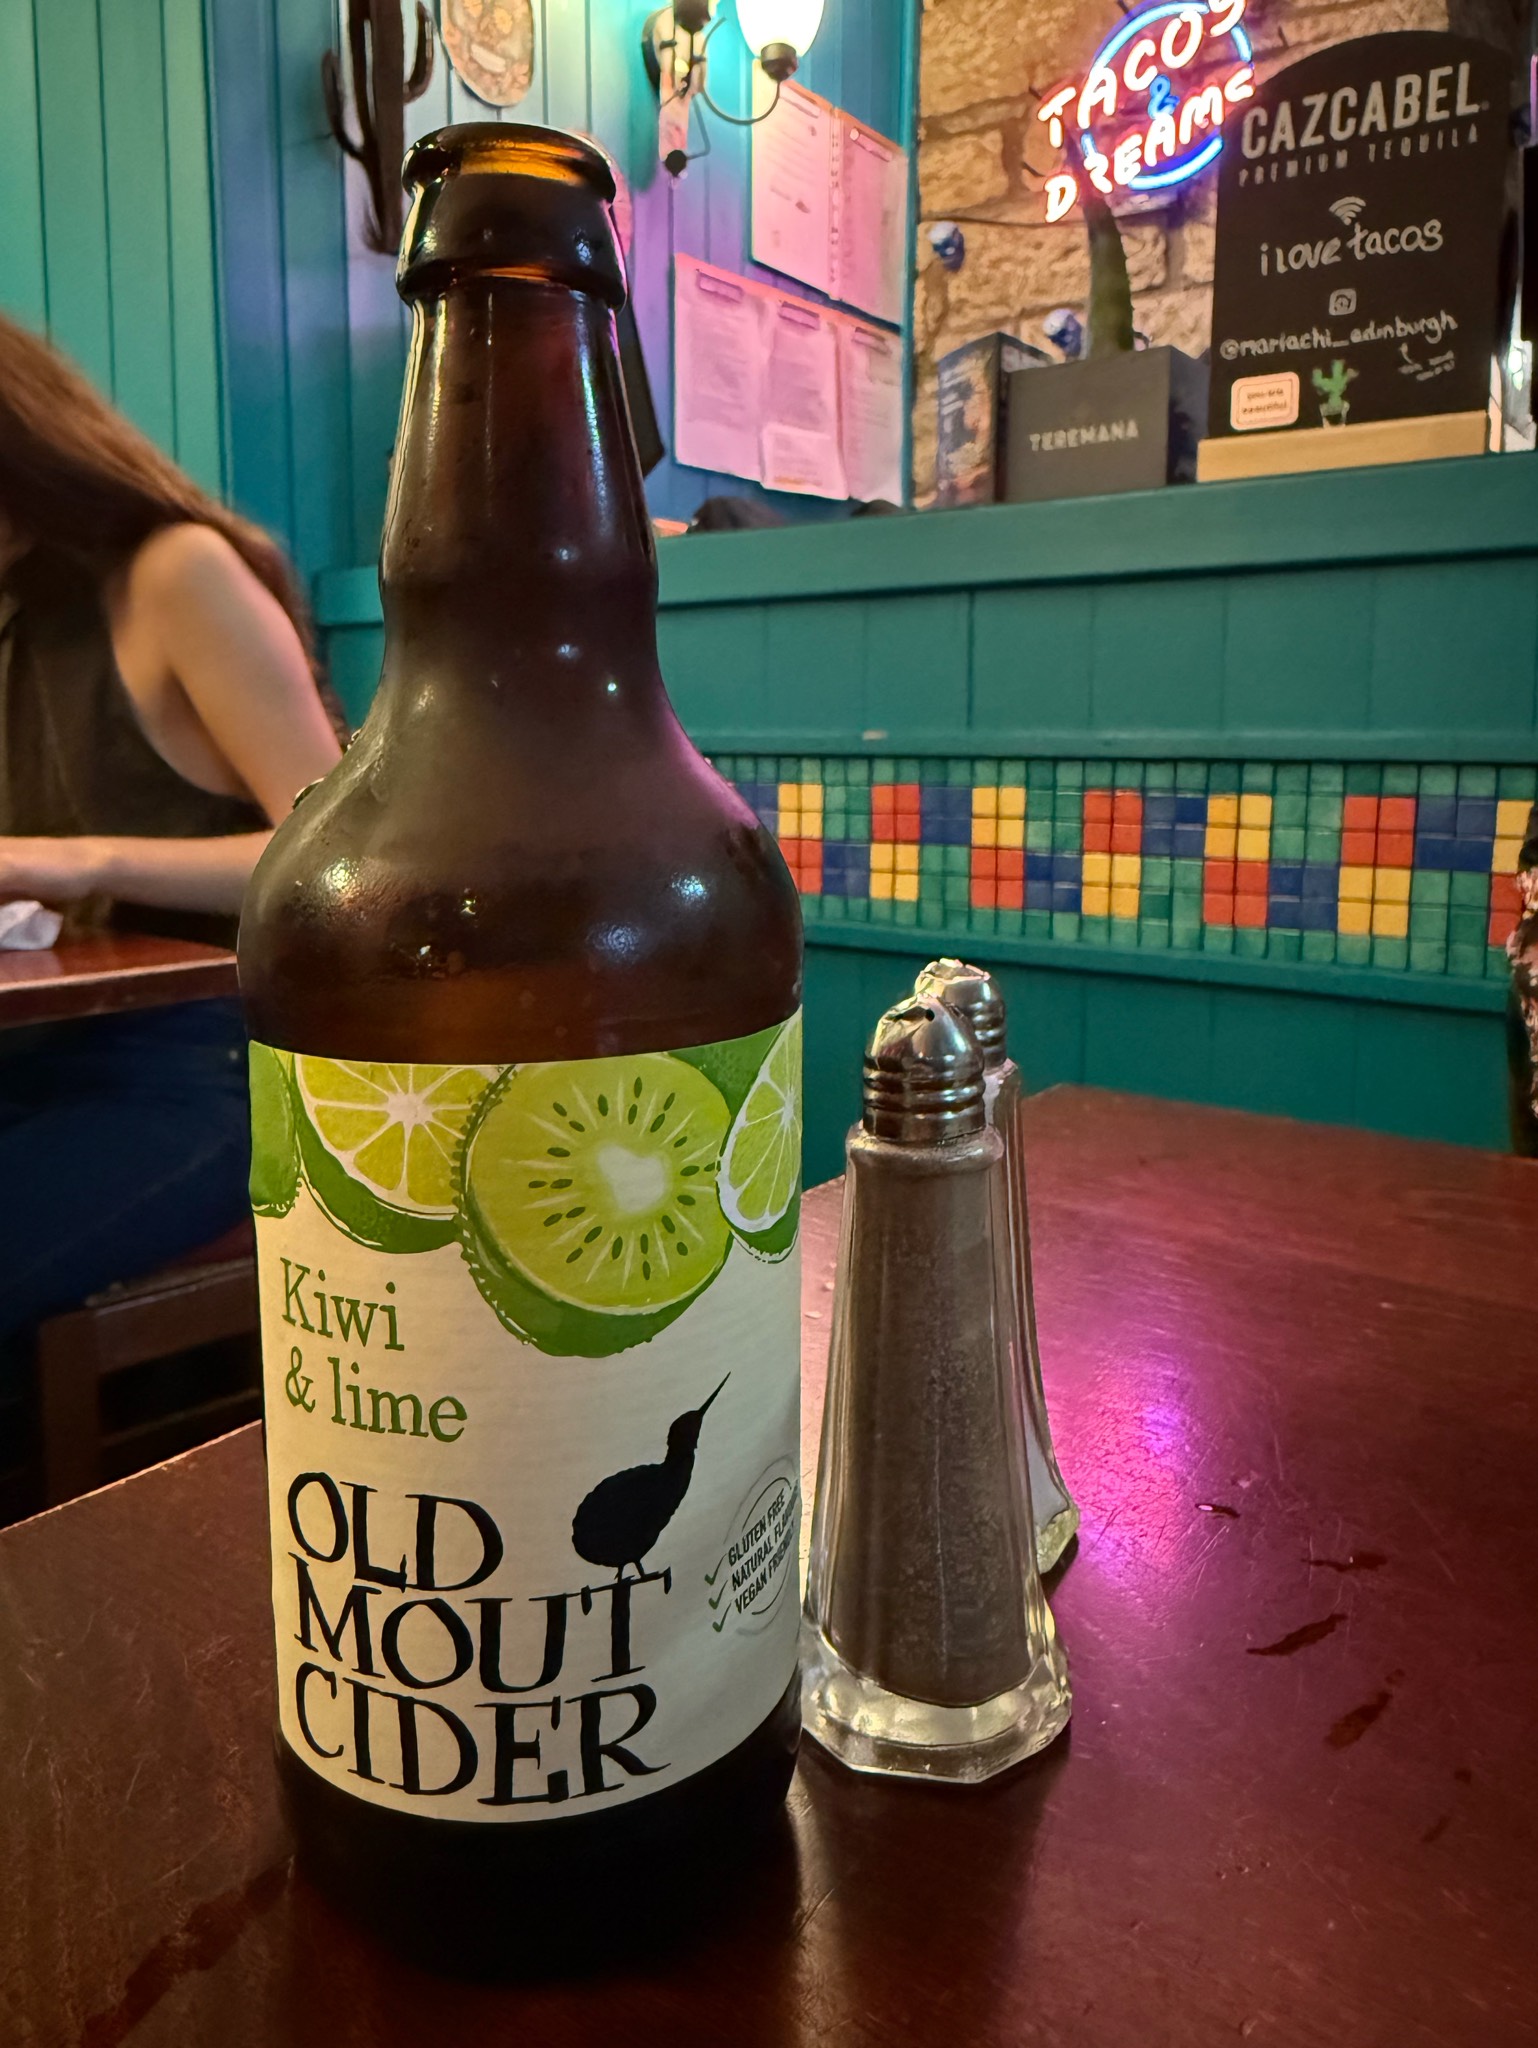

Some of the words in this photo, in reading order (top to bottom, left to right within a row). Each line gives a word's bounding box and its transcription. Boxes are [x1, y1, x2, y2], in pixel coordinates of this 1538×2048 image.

[1037, 0, 1248, 149] TACOS
[1148, 73, 1180, 120] &
[1241, 61, 1477, 160] CAZCABEL
[1368, 122, 1478, 163] TEQUILA
[1346, 218, 1444, 261] tacos
[280, 1257, 405, 1352] Kiwi
[285, 1346, 316, 1413] &
[329, 1356, 468, 1443] lime
[287, 1471, 504, 1593] OLD
[728, 1515, 767, 1567] GLUTEN
[767, 1487, 786, 1527] FREE
[731, 1536, 774, 1592] NATURAL
[287, 1552, 672, 1694] MOUT
[734, 1569, 768, 1615] VEGAN
[294, 1662, 672, 1807] CIDER
